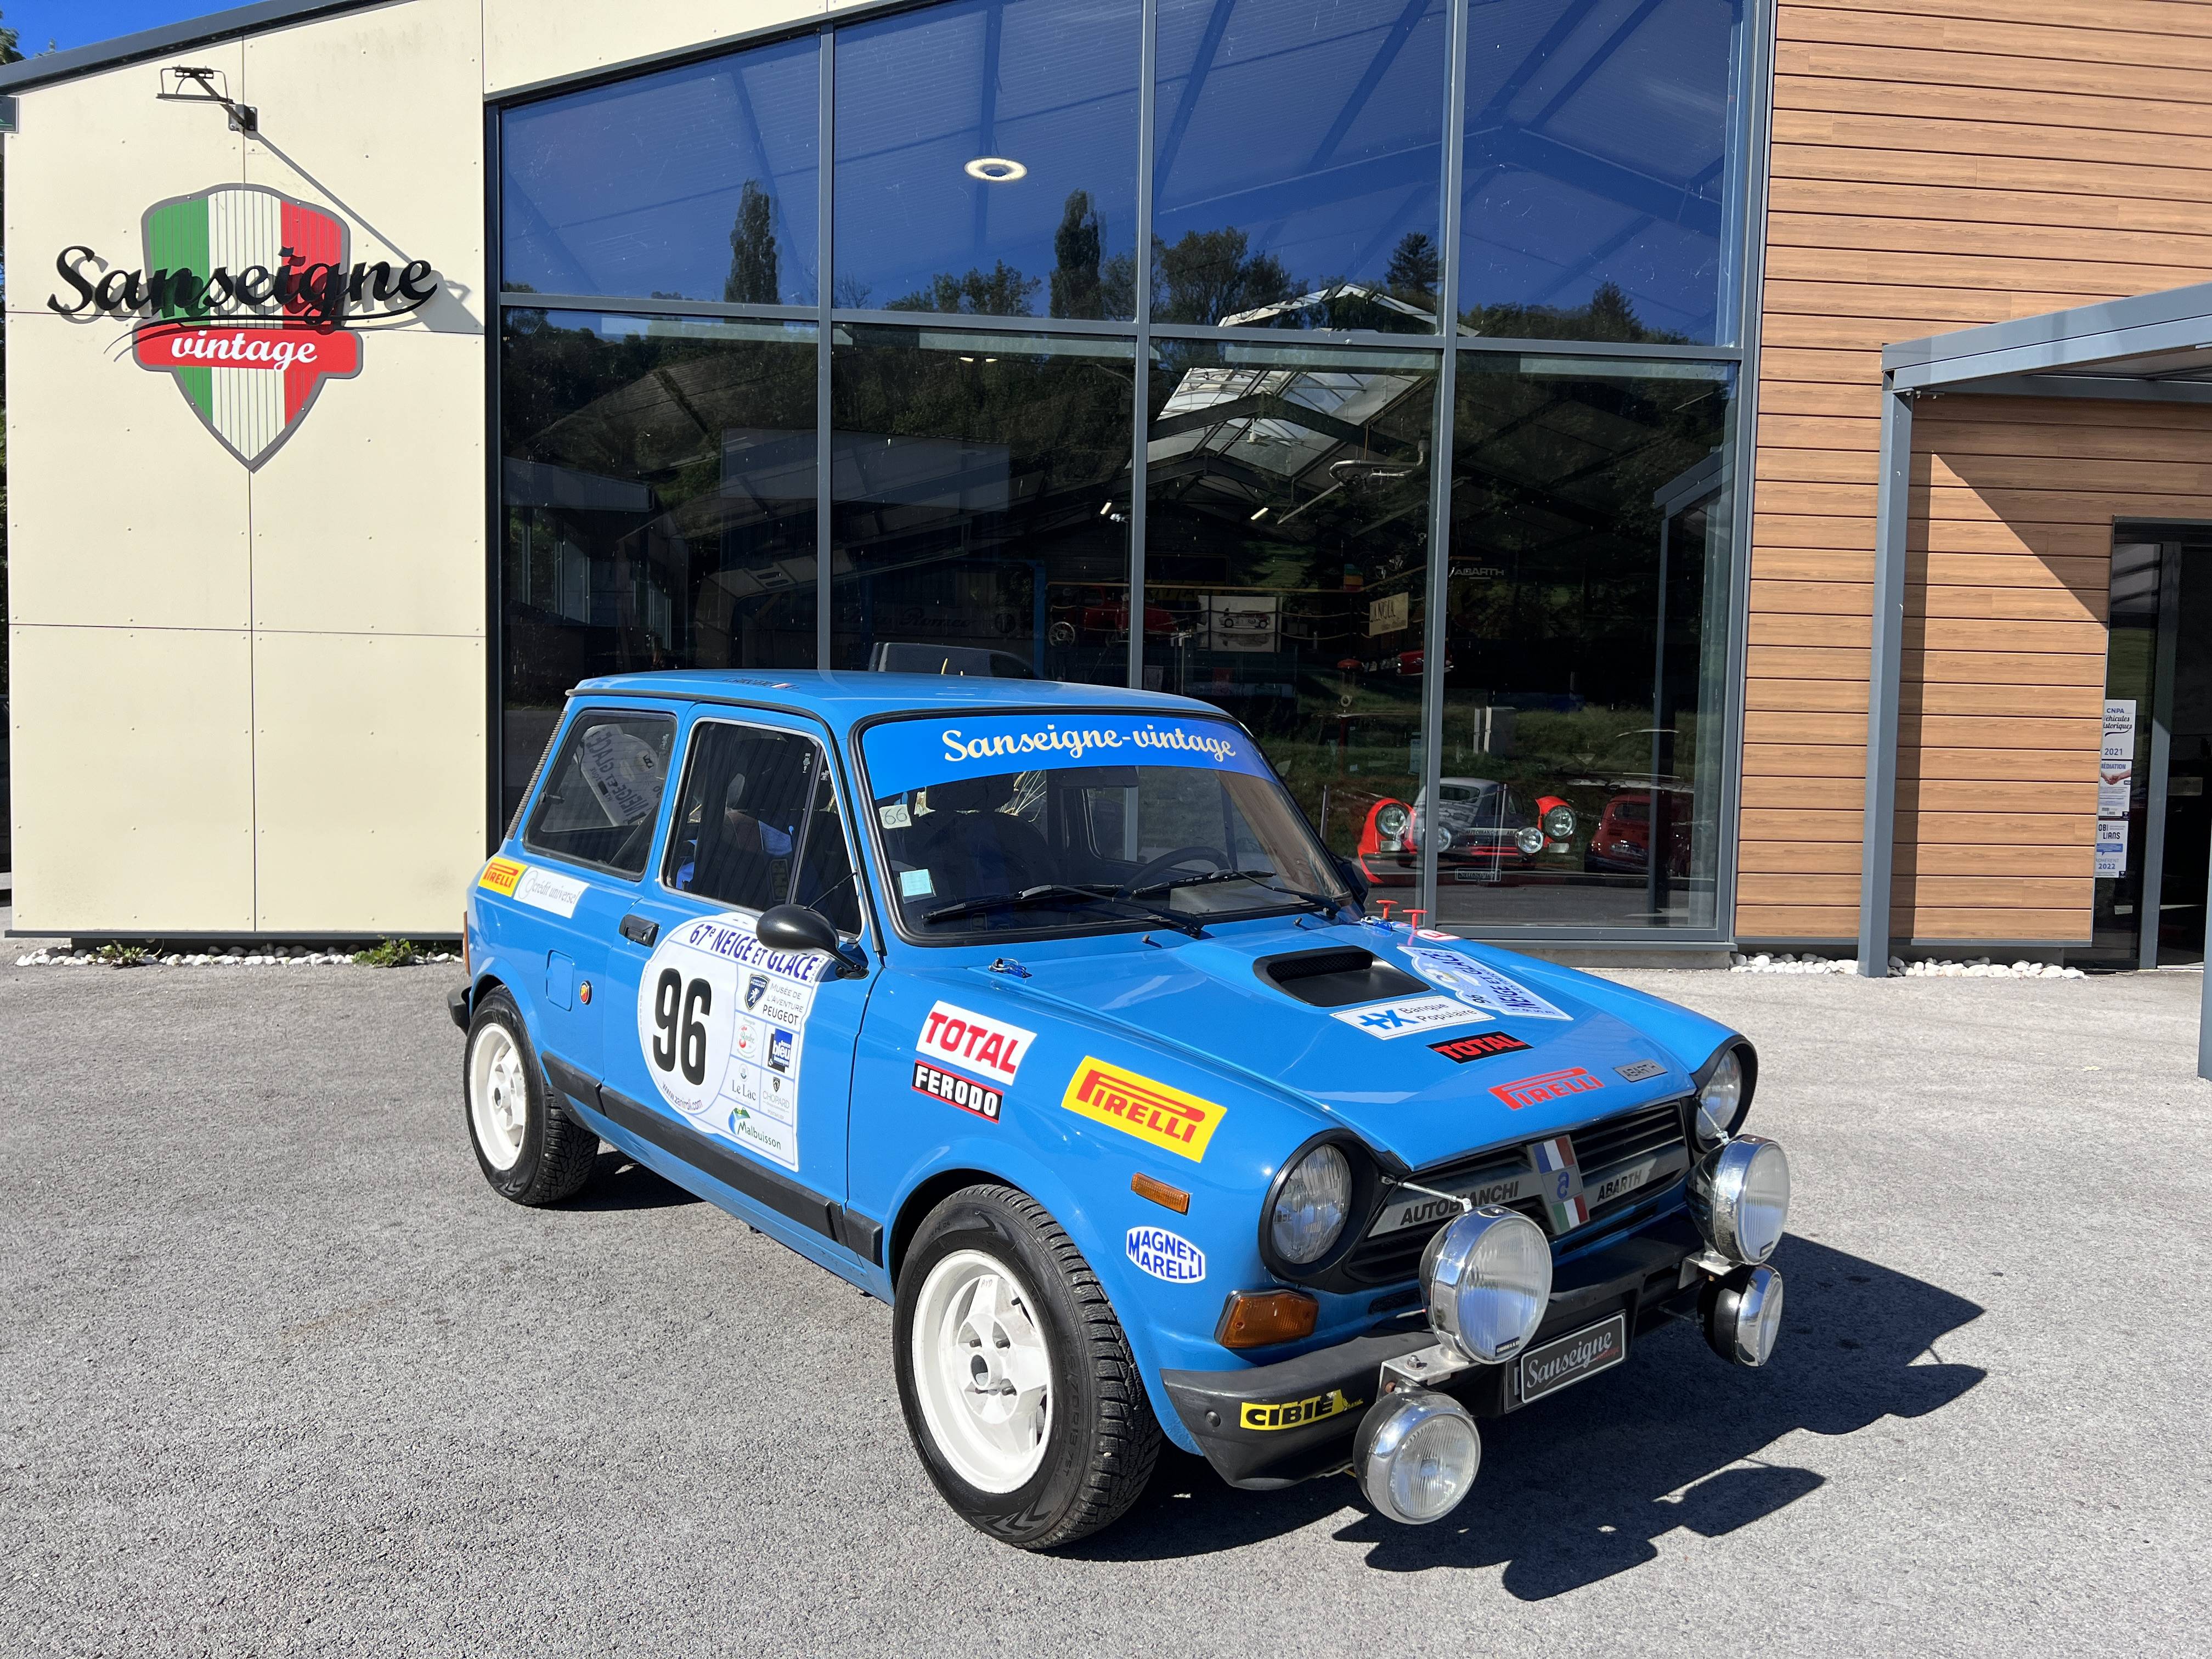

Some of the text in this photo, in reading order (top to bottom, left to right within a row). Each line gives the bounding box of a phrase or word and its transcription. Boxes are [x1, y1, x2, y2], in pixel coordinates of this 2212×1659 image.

[47, 245, 438, 325] Sanseigne
[171, 330, 317, 372] vintage
[1454, 567, 1505, 575] ABARTH
[2103, 722, 2132, 731] istoriques
[941, 723, 1236, 763] Sanseigne-vintage
[884, 808, 907, 825] 66
[483, 862, 518, 888] PIRELLI
[532, 880, 581, 904] crédit universel
[710, 929, 758, 961] NEIGE
[752, 947, 768, 966] ET
[767, 951, 820, 980] GLACE
[809, 958, 824, 983] 2022
[1420, 952, 1541, 1009] NEIGE ET GLACE
[766, 995, 804, 1013] L'AVENTURE
[770, 983, 802, 1000] MUSÉE DE
[1465, 994, 1493, 1005] 96
[763, 1005, 799, 1026] PEUGEOT
[1398, 1002, 1449, 1014] Banque
[1417, 1009, 1478, 1022] Populaire
[653, 968, 712, 1086] 96
[772, 1040, 791, 1060] bleu
[926, 1012, 1019, 1074] TOTAL
[1433, 1035, 1528, 1059] TOTAL
[1622, 1062, 1659, 1077] ABARTH
[732, 1080, 741, 1094] Le
[743, 1084, 757, 1101] Lac
[763, 1091, 790, 1109] CHOPARD
[915, 1065, 998, 1116] FERODO
[1488, 1067, 1605, 1110] PIRELLI
[1076, 1069, 1205, 1143] PIRELLI
[737, 1121, 782, 1150] Malbuisson
[1597, 1169, 1642, 1203] ABARTH
[1128, 1231, 1202, 1266] MAGNETI
[1128, 1240, 1202, 1279] MARELLI
[1527, 1332, 1612, 1389] Sanseigne
